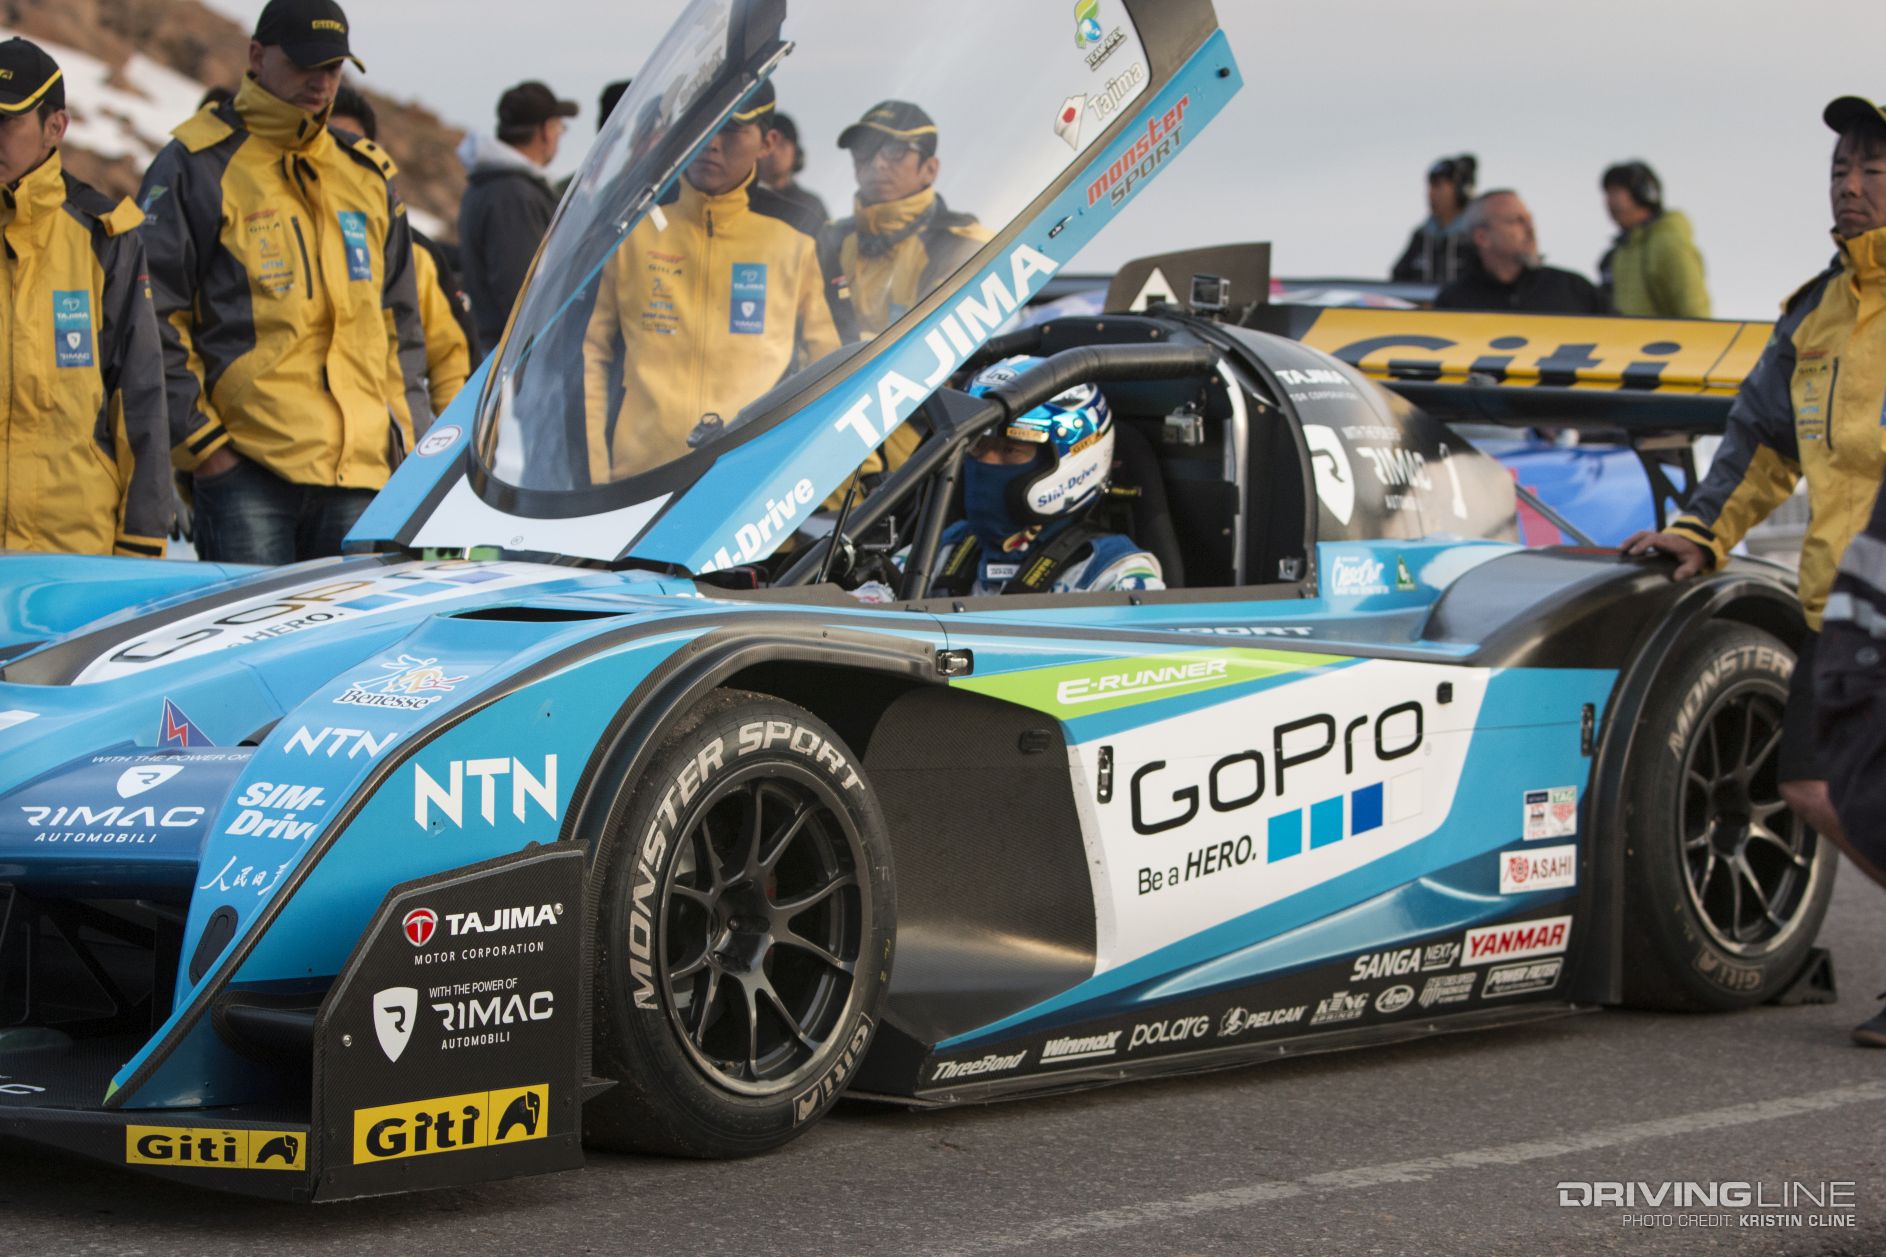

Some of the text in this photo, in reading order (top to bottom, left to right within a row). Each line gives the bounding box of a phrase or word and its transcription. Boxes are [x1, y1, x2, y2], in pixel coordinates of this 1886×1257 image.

[1088, 62, 1145, 121] Tajima
[1087, 95, 1189, 208] monster
[1110, 125, 1184, 207] SPORT
[834, 243, 1059, 449] TAJIMA
[1057, 659, 1228, 705] E-RUNNER
[339, 688, 431, 710] Benesse
[91, 755, 131, 763] WITH
[166, 754, 224, 762] POWER
[283, 726, 399, 759] NTN
[1130, 700, 1424, 836] GoPro
[237, 781, 326, 811] SIM-
[414, 754, 558, 831] NTN
[20, 806, 206, 829] RIMAC
[34, 833, 157, 844] AUTOMOBILI
[629, 720, 866, 1011] MONSTER SPORT
[1137, 834, 1257, 896] Be a HERO.
[1531, 856, 1572, 881] ASAHI
[445, 903, 558, 936] TAJIMA
[414, 941, 544, 966] MOTOR CORPORATION
[1470, 924, 1566, 959] YANMAR
[1349, 948, 1421, 982] SANGA
[429, 977, 518, 999] WITH THE POWER OF
[431, 990, 554, 1031] RIMAC
[1246, 1006, 1308, 1028] PELICAN
[441, 1031, 510, 1050] AUTOMOBILI
[1042, 1030, 1124, 1059] Winmax
[931, 1050, 1028, 1081] ThreeBond
[137, 1133, 237, 1162] Giti
[366, 1105, 481, 1157] Giti
